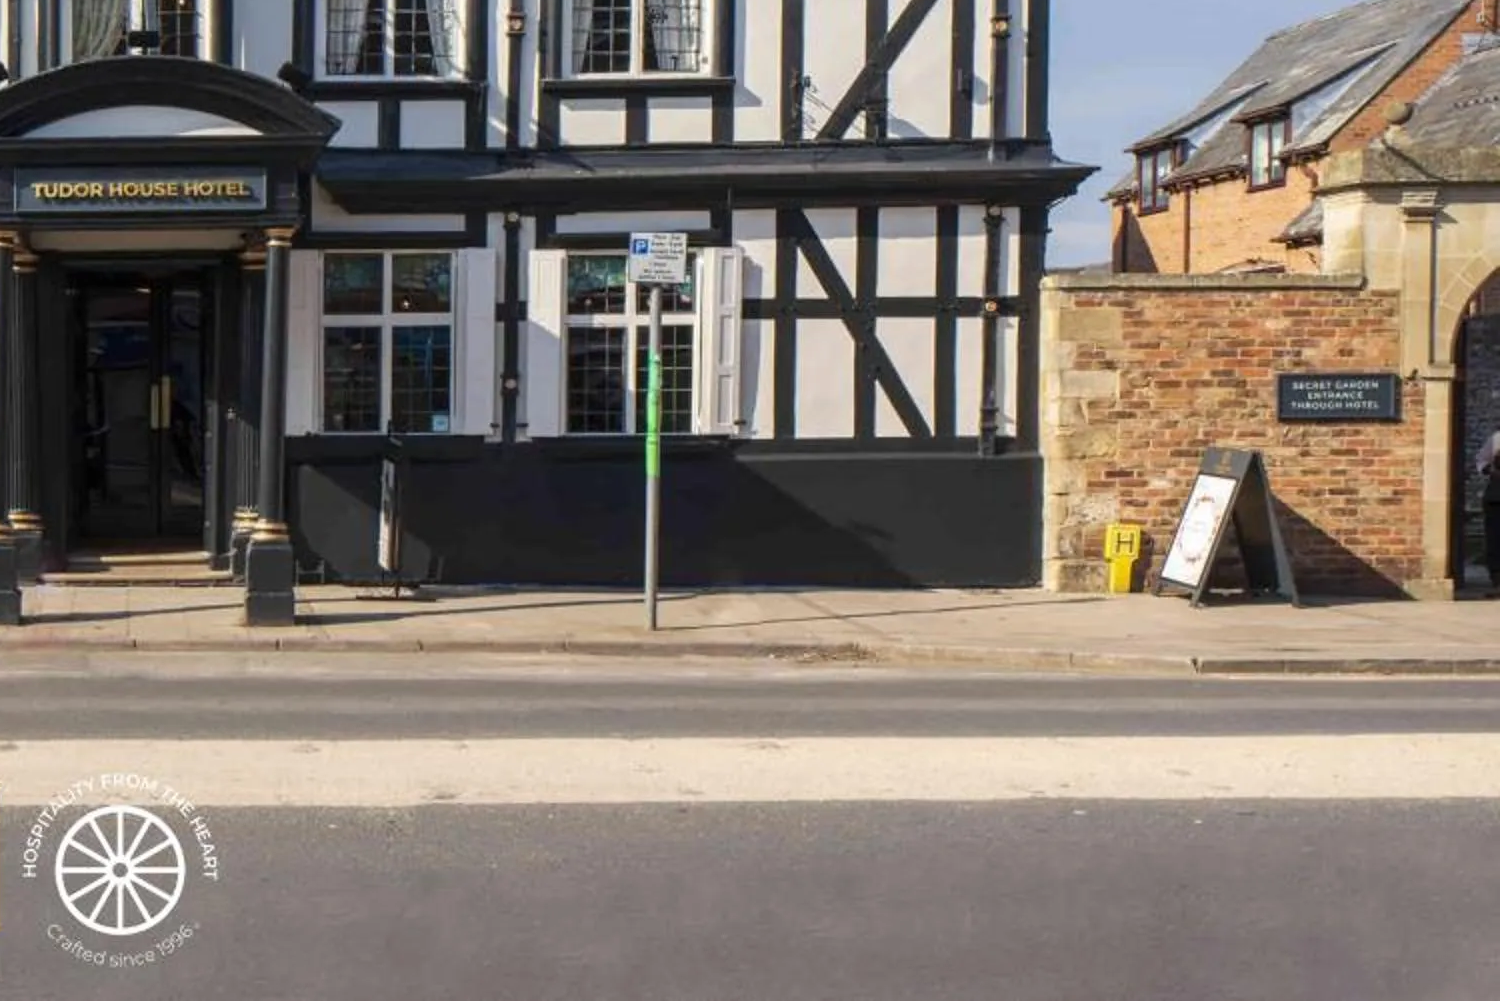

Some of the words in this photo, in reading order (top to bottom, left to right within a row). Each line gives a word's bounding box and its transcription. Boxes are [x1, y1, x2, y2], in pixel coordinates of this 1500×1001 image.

[31, 182, 104, 197] TUDOR
[109, 181, 178, 196] HOUSE
[184, 179, 250, 196] HOTEL
[1292, 381, 1331, 390] SECRET
[1335, 380, 1379, 390] GARDEN
[1307, 391, 1364, 400] ENTRANCE
[1290, 401, 1342, 410] THROUGH
[1345, 400, 1379, 409] HOTEL
[1116, 532, 1134, 554] H
